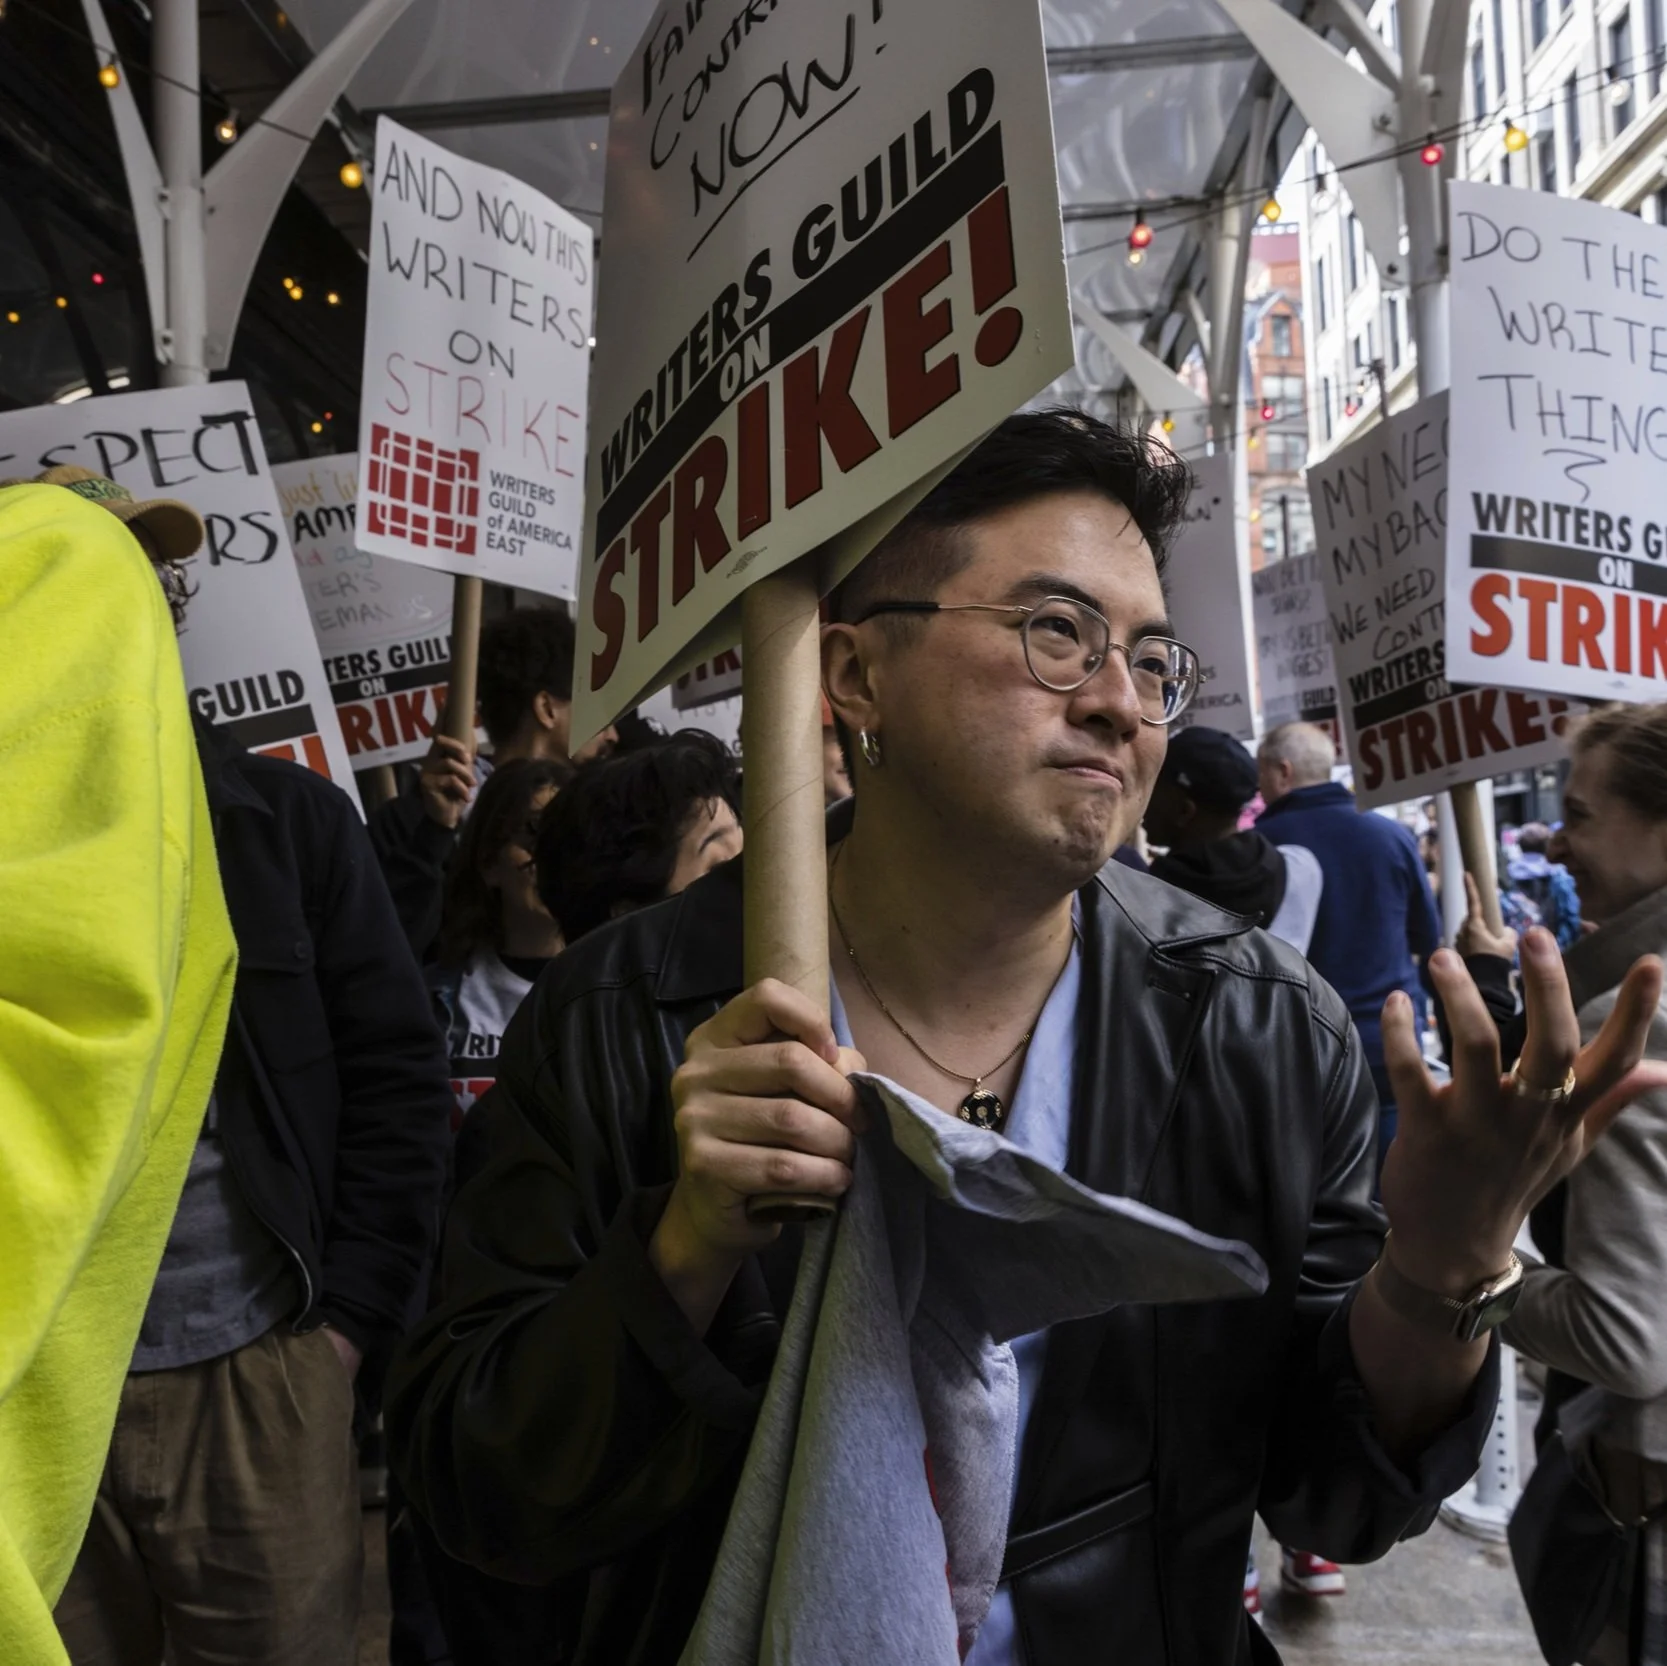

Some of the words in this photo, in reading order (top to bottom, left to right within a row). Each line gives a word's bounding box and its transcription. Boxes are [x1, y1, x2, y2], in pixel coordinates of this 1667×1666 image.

[651, 0, 778, 170] CONTR
[381, 141, 463, 222] AND
[476, 191, 536, 256] NOW
[543, 221, 588, 287] THIS
[383, 221, 587, 349] WRITERS
[601, 247, 773, 498] WRITERS
[793, 67, 995, 280] GUILD
[1457, 211, 1541, 263] DO
[1562, 236, 1665, 300] THE
[449, 330, 515, 379] ON
[719, 321, 771, 403] ON
[385, 353, 580, 478] STRIKE
[591, 185, 1023, 691] STRIKE!
[488, 491, 537, 519] GUILD
[489, 469, 556, 506] WRITERS
[1322, 457, 1372, 530] MY
[203, 511, 279, 567] RS
[486, 531, 526, 556] EAST
[487, 513, 504, 531] of
[507, 518, 573, 552] AMERICA
[1470, 491, 1632, 554] WRITERS
[1332, 522, 1383, 587] MY
[1598, 556, 1634, 589] ON
[1329, 601, 1369, 645] WE
[1374, 568, 1436, 620] NEED
[387, 636, 452, 669] GUIL
[1347, 639, 1445, 703] WRITERS
[189, 669, 305, 723] GUILD
[359, 676, 387, 697] ON
[1424, 677, 1453, 700] ON
